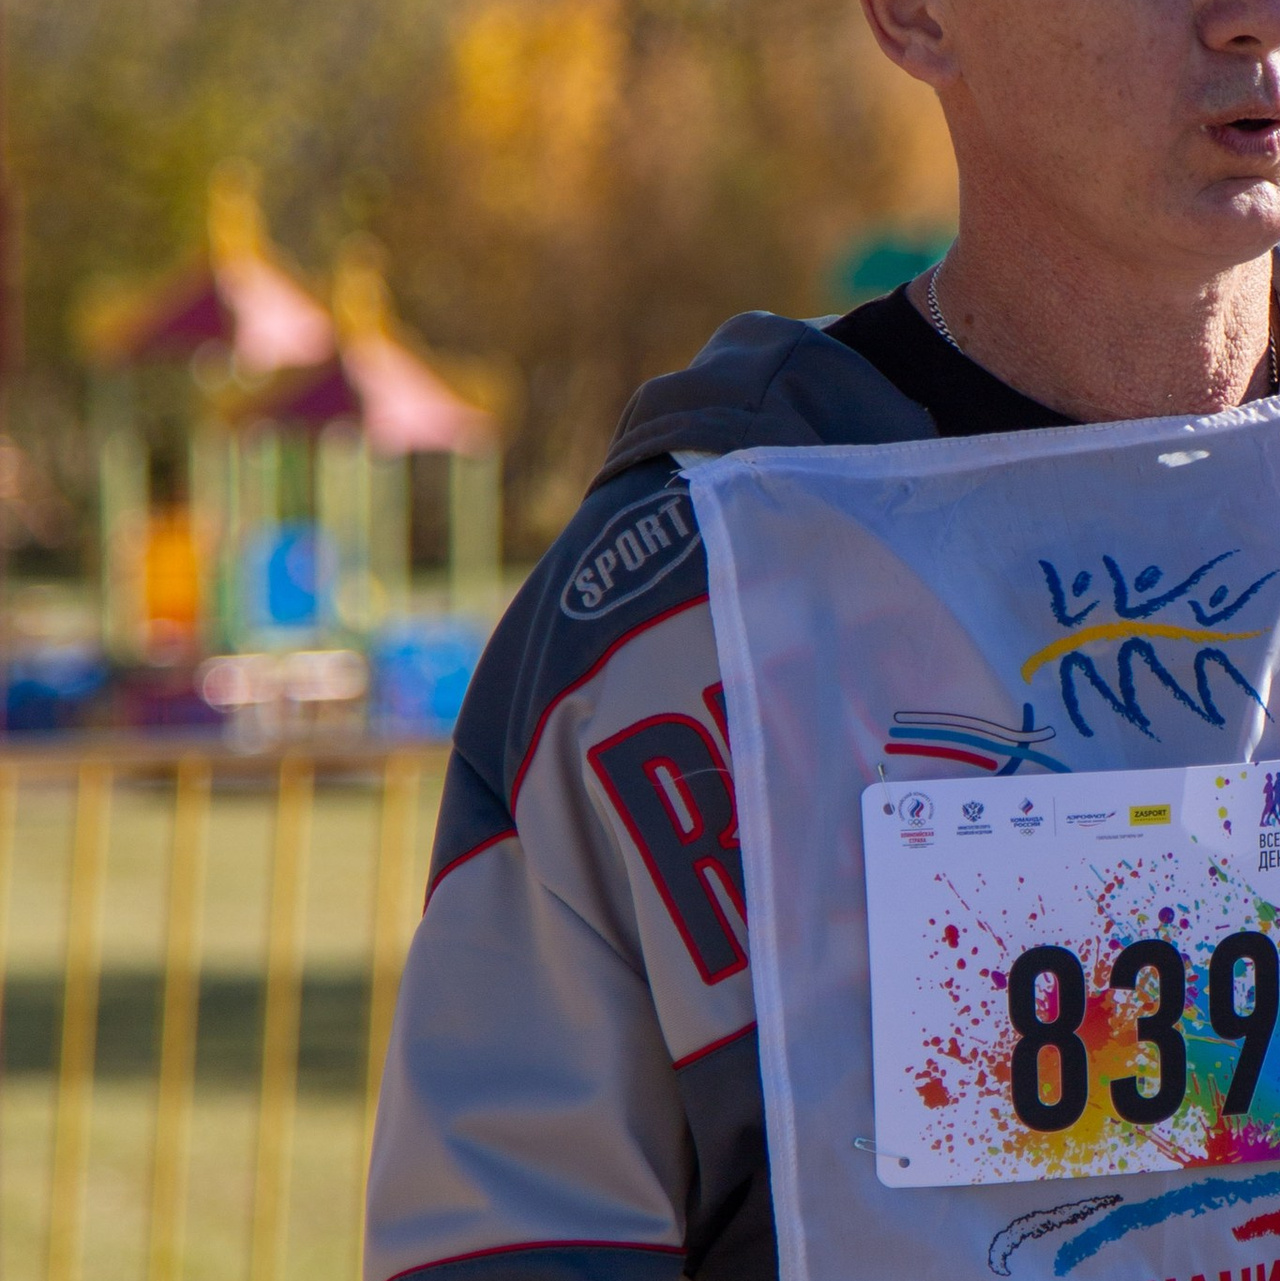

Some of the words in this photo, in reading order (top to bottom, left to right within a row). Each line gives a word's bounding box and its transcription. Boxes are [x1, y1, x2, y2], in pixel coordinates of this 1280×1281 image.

[574, 496, 691, 608] SPORT
[1133, 809, 1167, 818] ZASPORT
[1007, 931, 1280, 1134] 839
